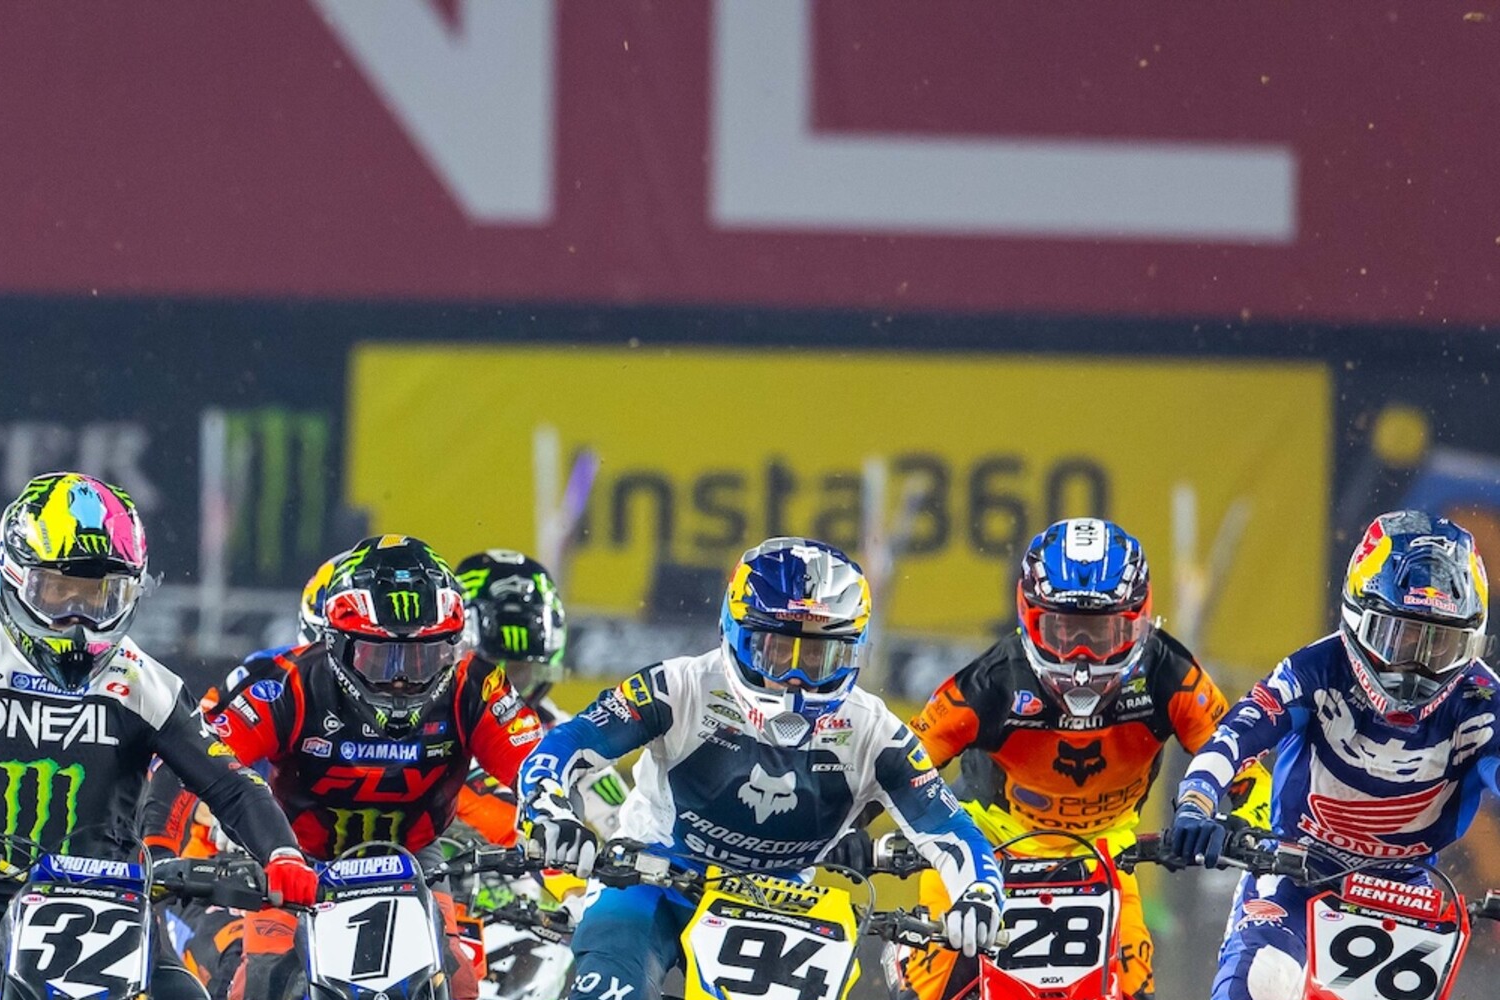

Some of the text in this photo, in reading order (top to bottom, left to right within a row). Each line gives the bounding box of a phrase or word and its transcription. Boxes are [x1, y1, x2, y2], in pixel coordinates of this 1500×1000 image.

[357, 744, 418, 760] YAMAHA
[311, 763, 448, 803] FLY
[679, 811, 828, 855] PROGRESSIVE
[1297, 813, 1434, 858] HONDA
[1350, 884, 1436, 912] RENTHAL
[1352, 872, 1438, 900] RENTHAL
[17, 902, 142, 985] 32
[347, 898, 399, 982] 1
[997, 905, 1105, 970] 28
